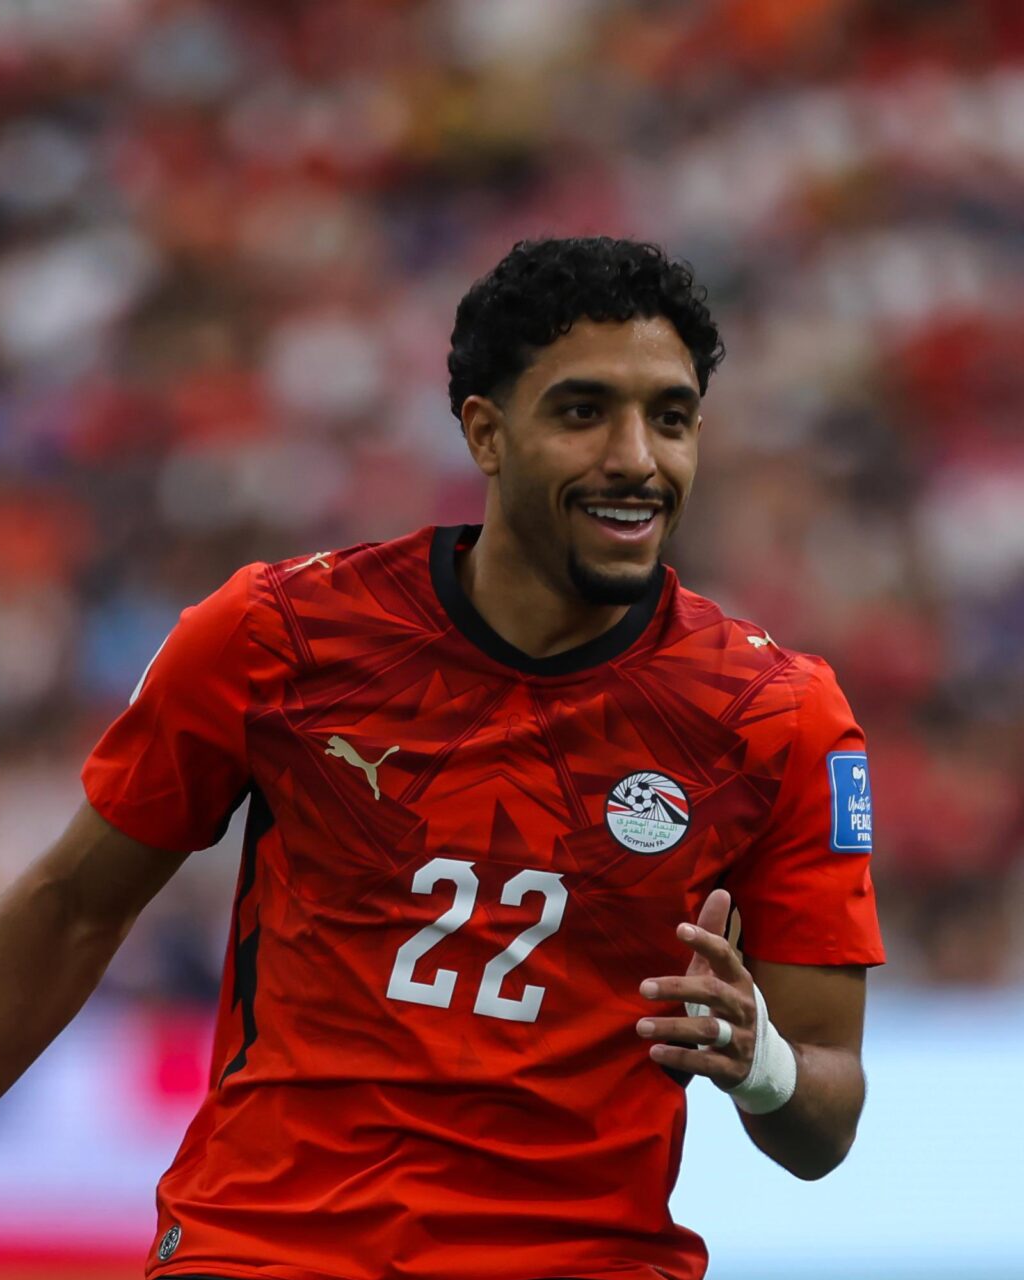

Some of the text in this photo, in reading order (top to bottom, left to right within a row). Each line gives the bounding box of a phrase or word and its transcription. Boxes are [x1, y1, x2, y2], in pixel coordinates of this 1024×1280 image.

[851, 813, 871, 831] PEAC
[623, 834, 666, 849] EGYPTIAN FA
[386, 857, 569, 1023] 22
